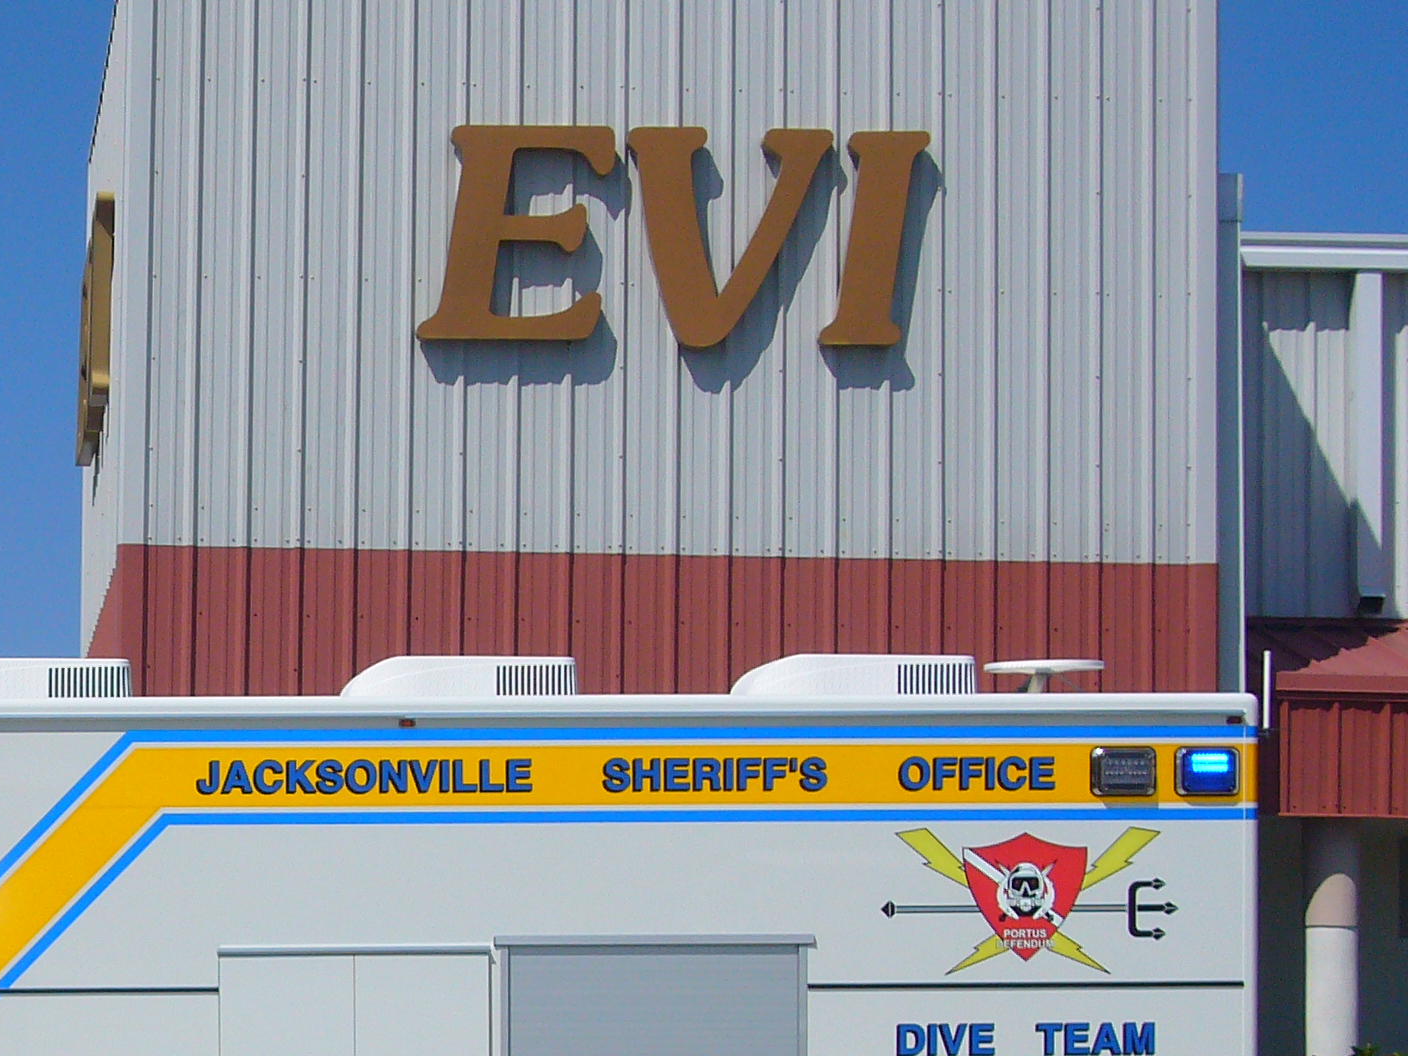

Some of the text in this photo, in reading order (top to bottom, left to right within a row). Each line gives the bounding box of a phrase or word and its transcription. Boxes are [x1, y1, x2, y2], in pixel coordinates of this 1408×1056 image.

[415, 125, 931, 347] EVI
[195, 755, 1056, 795] JACKSONVILLE SHERIFF'S OFFICE
[1003, 928, 1048, 939] PORTUS
[895, 1022, 1156, 1056] DIVE TEAM
